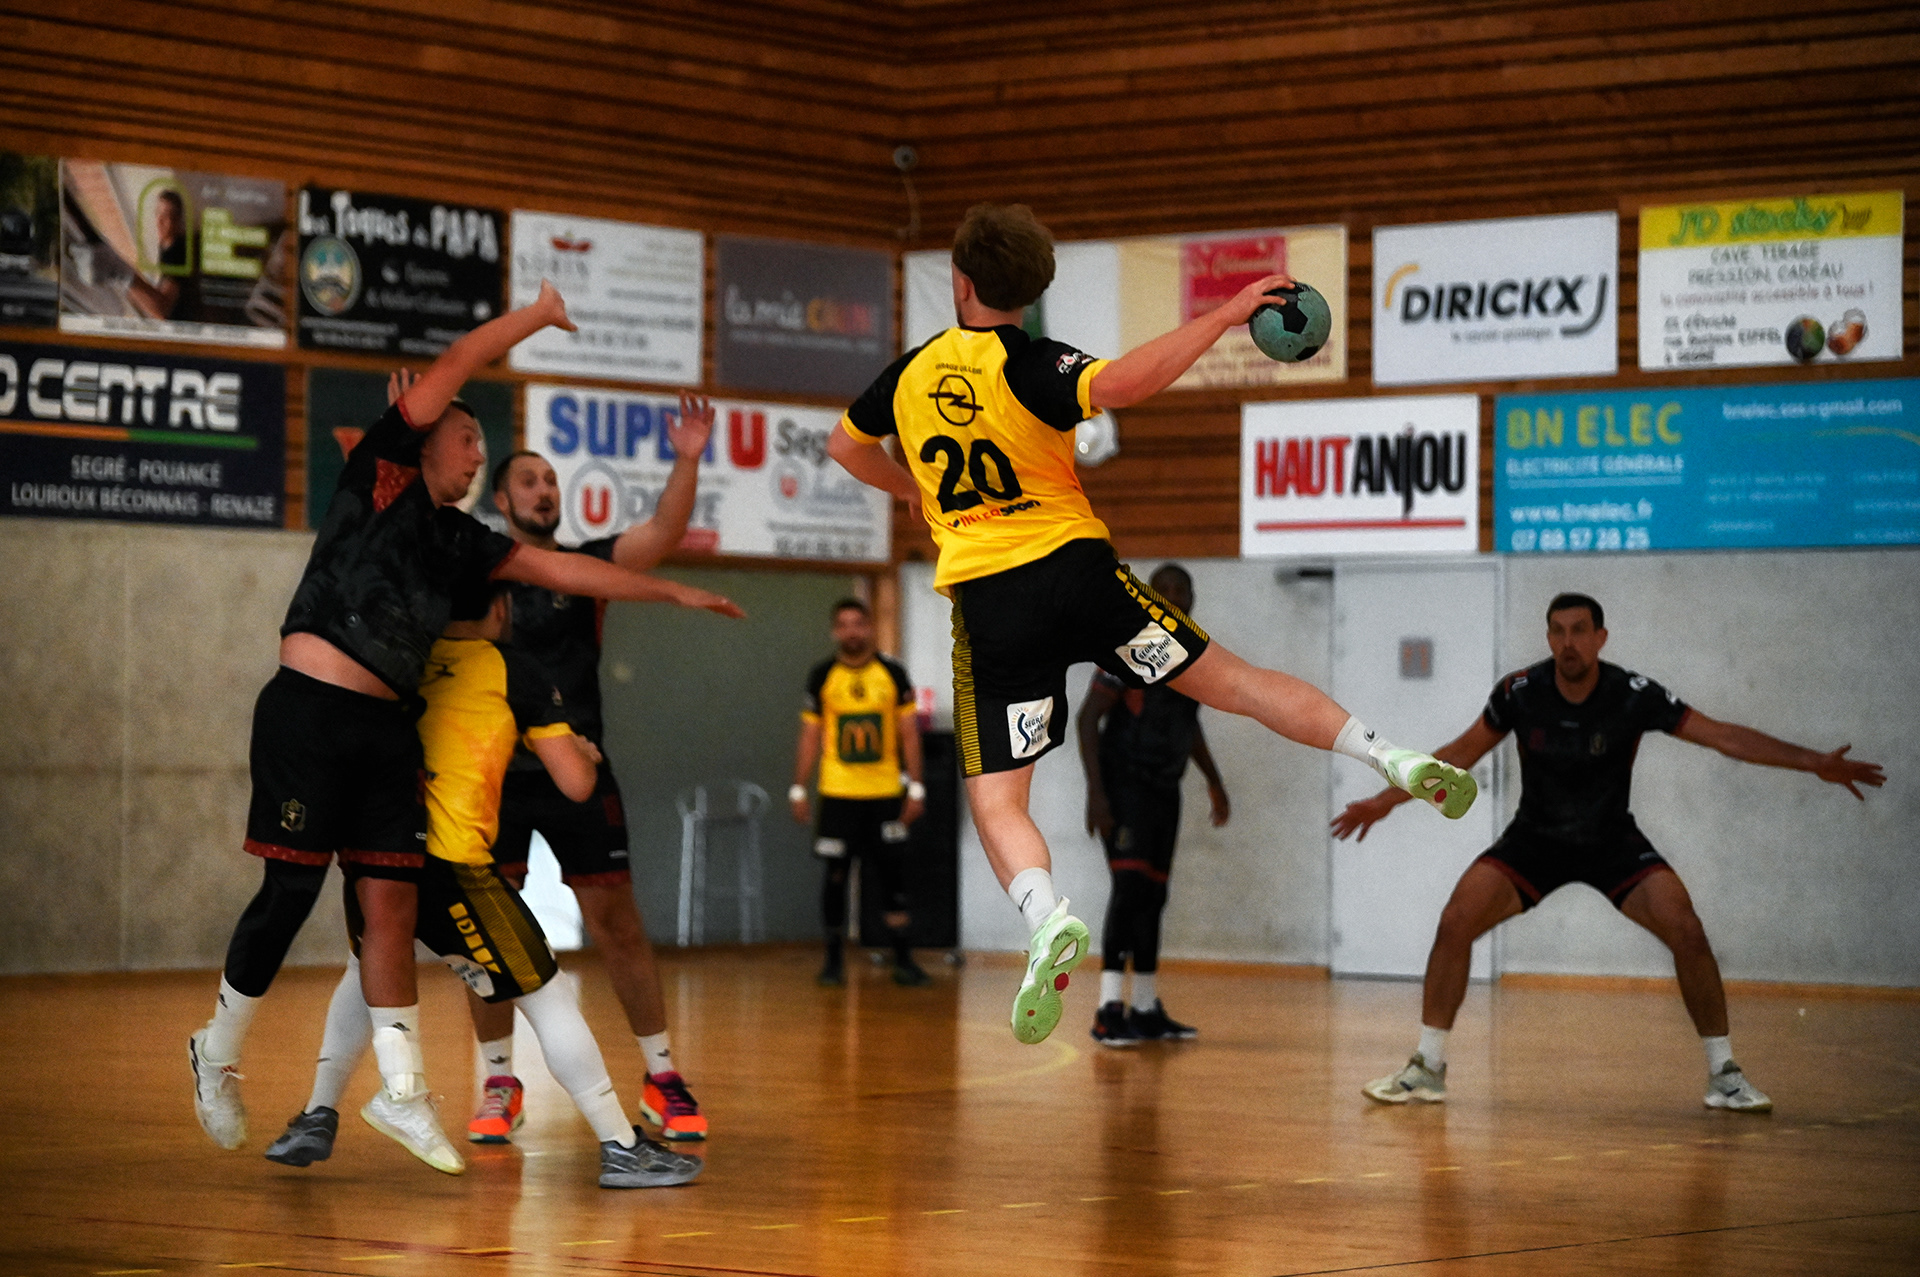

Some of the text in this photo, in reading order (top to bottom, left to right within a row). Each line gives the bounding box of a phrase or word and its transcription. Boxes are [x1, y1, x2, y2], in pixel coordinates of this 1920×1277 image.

[430, 205, 499, 263] PAPA
[1669, 204, 1719, 245] JD
[1762, 240, 1819, 261] TIRAGE
[1777, 262, 1844, 283] CADEAU
[1400, 274, 1584, 325] DIRICKX
[27, 358, 242, 432] CENTRE
[548, 392, 714, 463] SUPE
[729, 410, 766, 470] U
[1507, 402, 1684, 449] BN ELEC
[71, 455, 127, 481] SEGRÉ
[920, 435, 1023, 514] 20
[11, 482, 97, 510] LOUROUX
[99, 485, 200, 517] BÉCONNAIS
[582, 486, 610, 526] U
[1147, 653, 1158, 663] EN
[1155, 651, 1171, 669] BLEU
